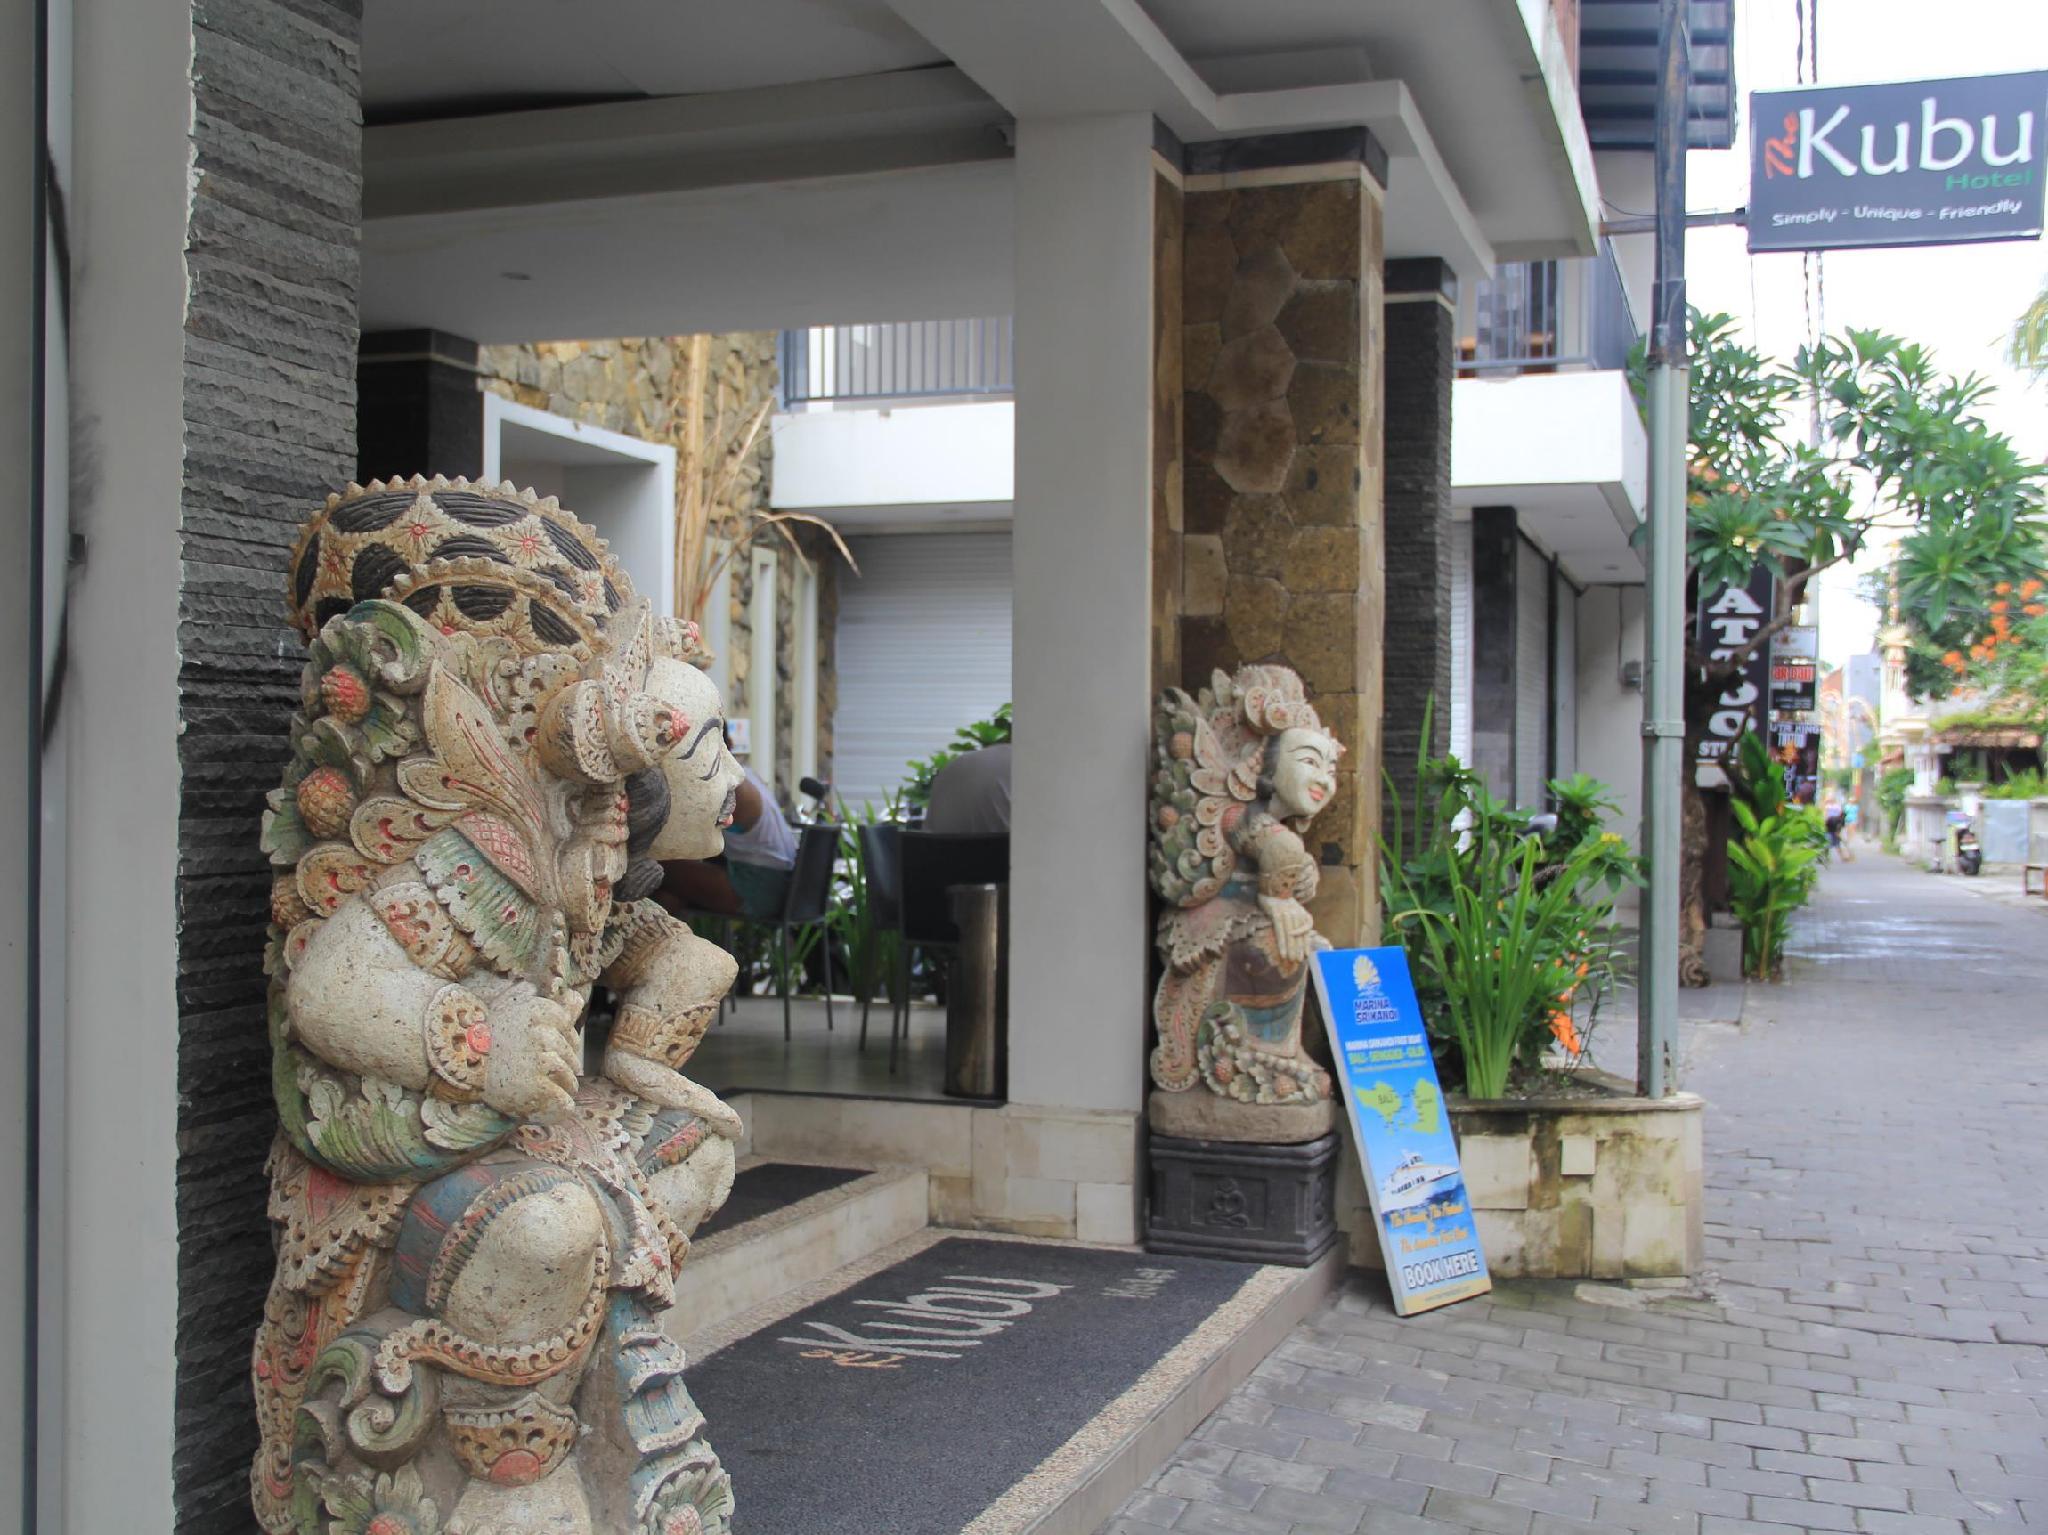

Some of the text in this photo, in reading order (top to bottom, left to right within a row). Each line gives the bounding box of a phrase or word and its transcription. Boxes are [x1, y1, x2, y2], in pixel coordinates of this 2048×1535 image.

[1764, 97, 2034, 180] The Kubu
[1945, 169, 2034, 191] Hotel
[1771, 207, 1837, 227] Simply
[1853, 205, 1923, 222] Unique
[1938, 199, 2023, 220] Friendly
[1706, 585, 1764, 737] ATOO
[1403, 1249, 1480, 1289] BOOK HERE
[776, 1274, 1074, 1359] Kubu
